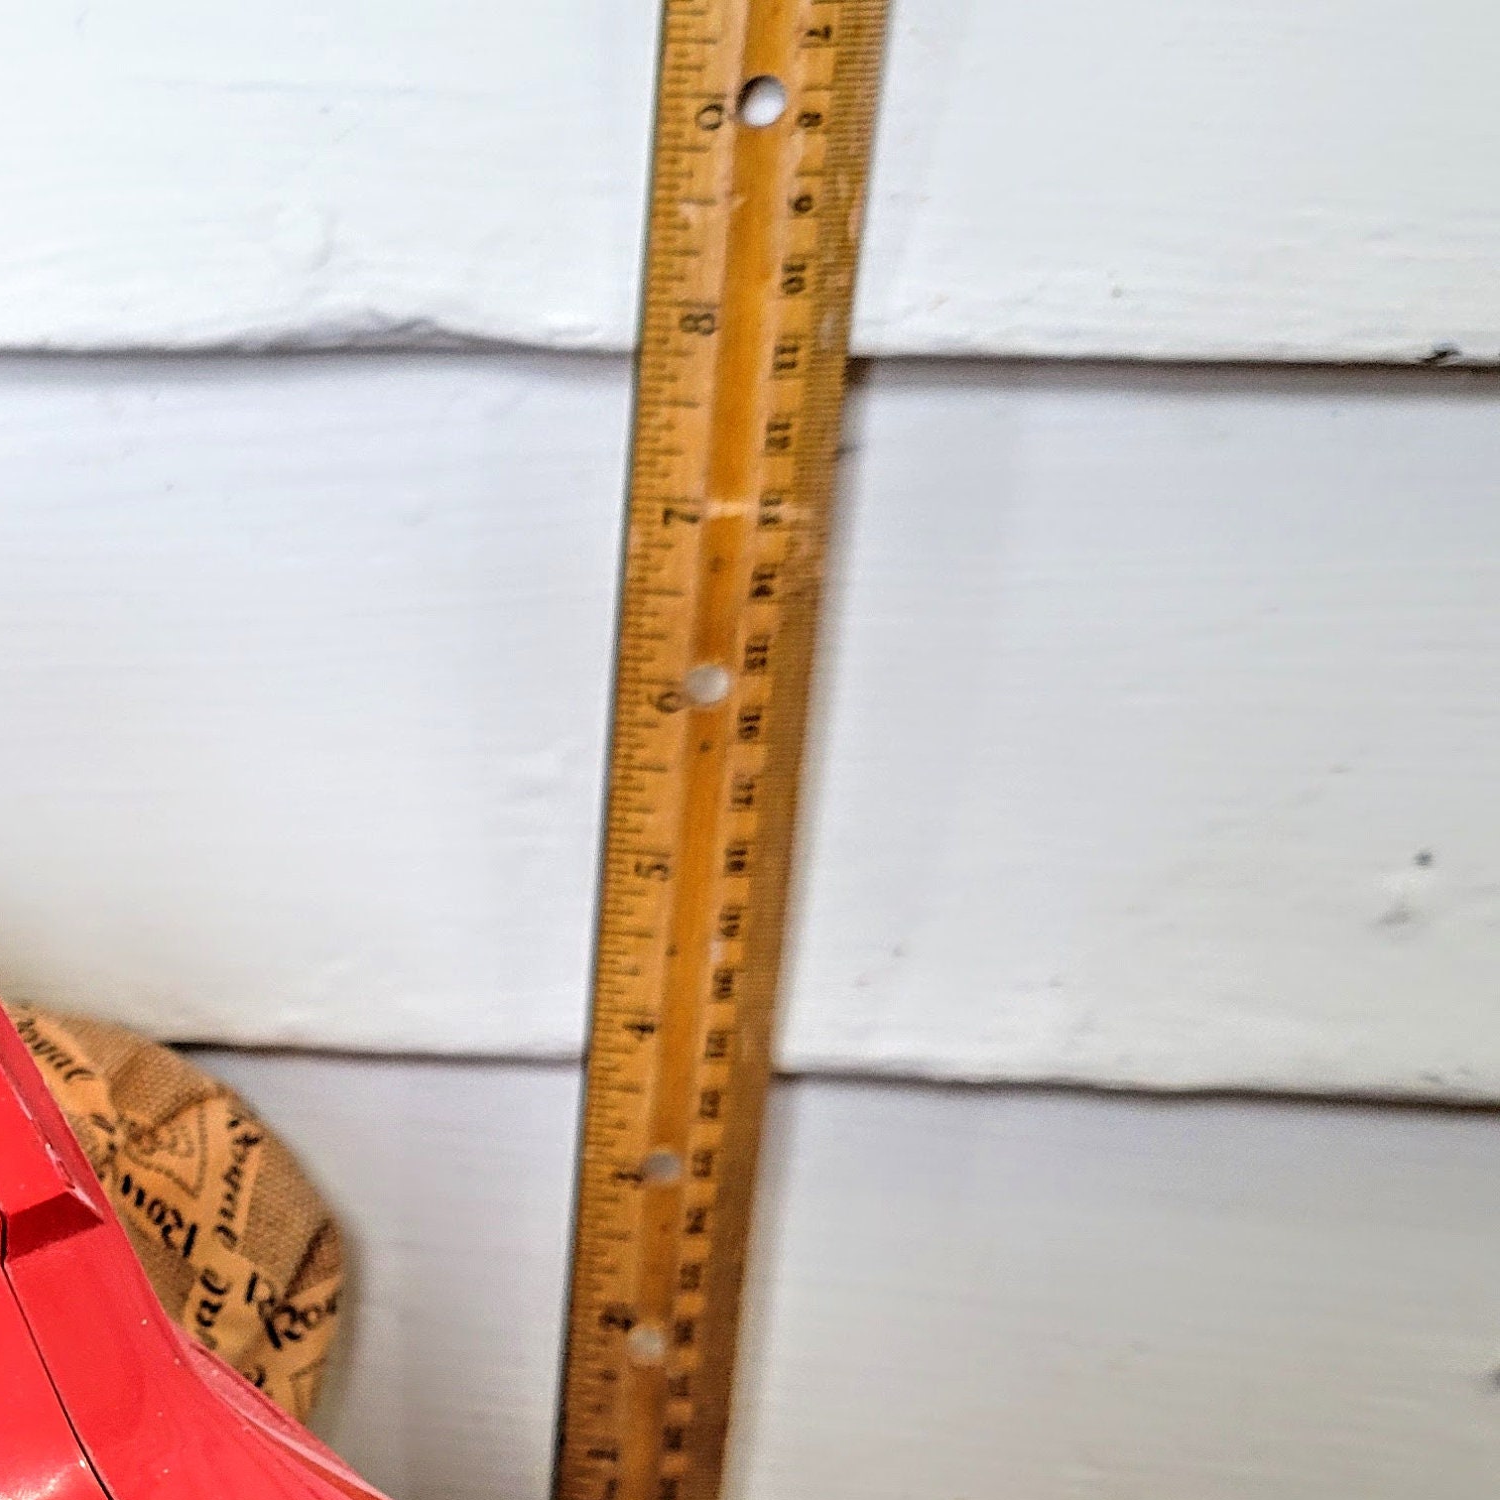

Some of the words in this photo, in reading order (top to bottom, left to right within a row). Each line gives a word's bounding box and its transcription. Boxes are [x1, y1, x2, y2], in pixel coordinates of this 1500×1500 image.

[781, 263, 806, 294] 10
[680, 312, 718, 336] 8
[774, 343, 799, 370] 11
[663, 508, 700, 525] 7
[634, 861, 669, 880] 5
